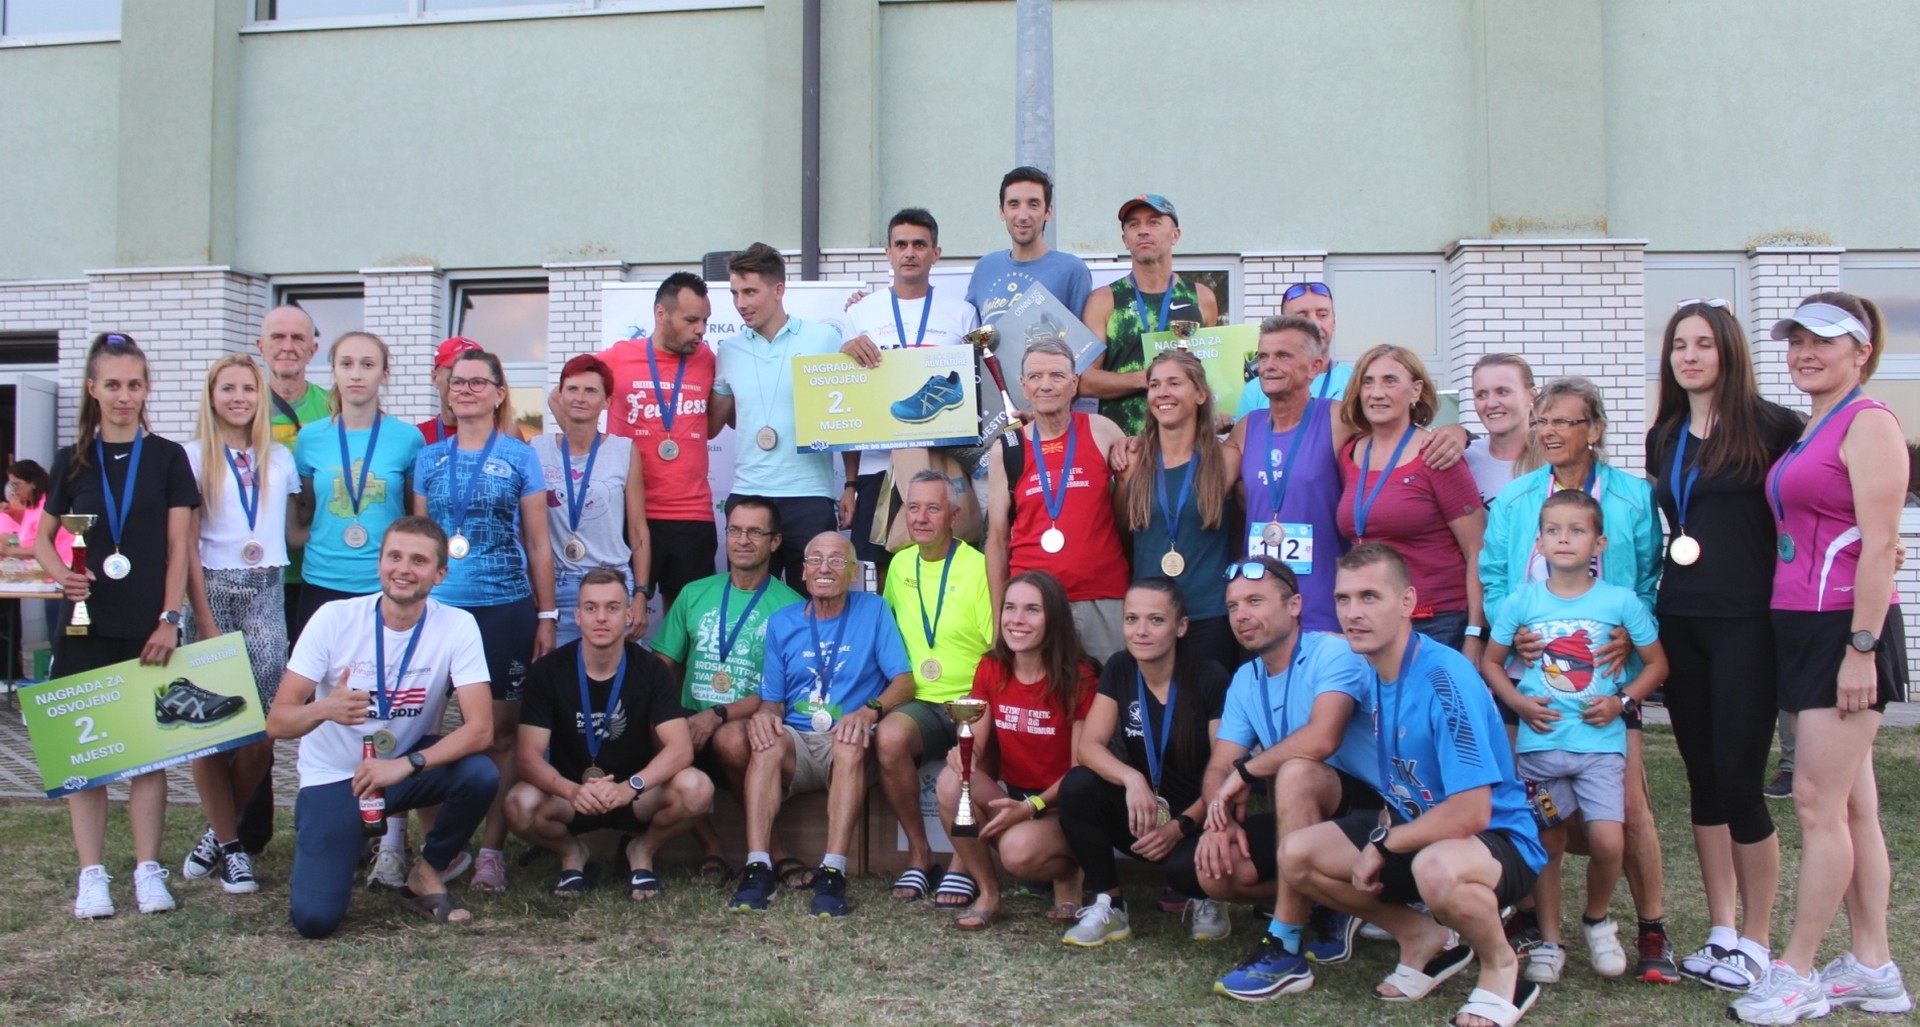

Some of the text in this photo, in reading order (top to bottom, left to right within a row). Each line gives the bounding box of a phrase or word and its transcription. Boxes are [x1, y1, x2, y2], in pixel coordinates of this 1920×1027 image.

[1034, 295, 1046, 306] GO
[706, 323, 736, 334] RKA
[1154, 336, 1222, 350] NAGADA ZA
[803, 362, 855, 374] NAGRADA
[809, 374, 868, 386] OSVOJENO
[826, 390, 852, 415] 2.
[820, 419, 863, 431] MJESTO
[694, 660, 732, 674] BRDSKA
[733, 666, 761, 681] UTRKA
[35, 673, 126, 705] NAGRADA ZA
[47, 690, 122, 718] OSVOJENO
[74, 716, 109, 745] 2.
[70, 742, 125, 766] MJESTO
[187, 746, 219, 760] MJESTA
